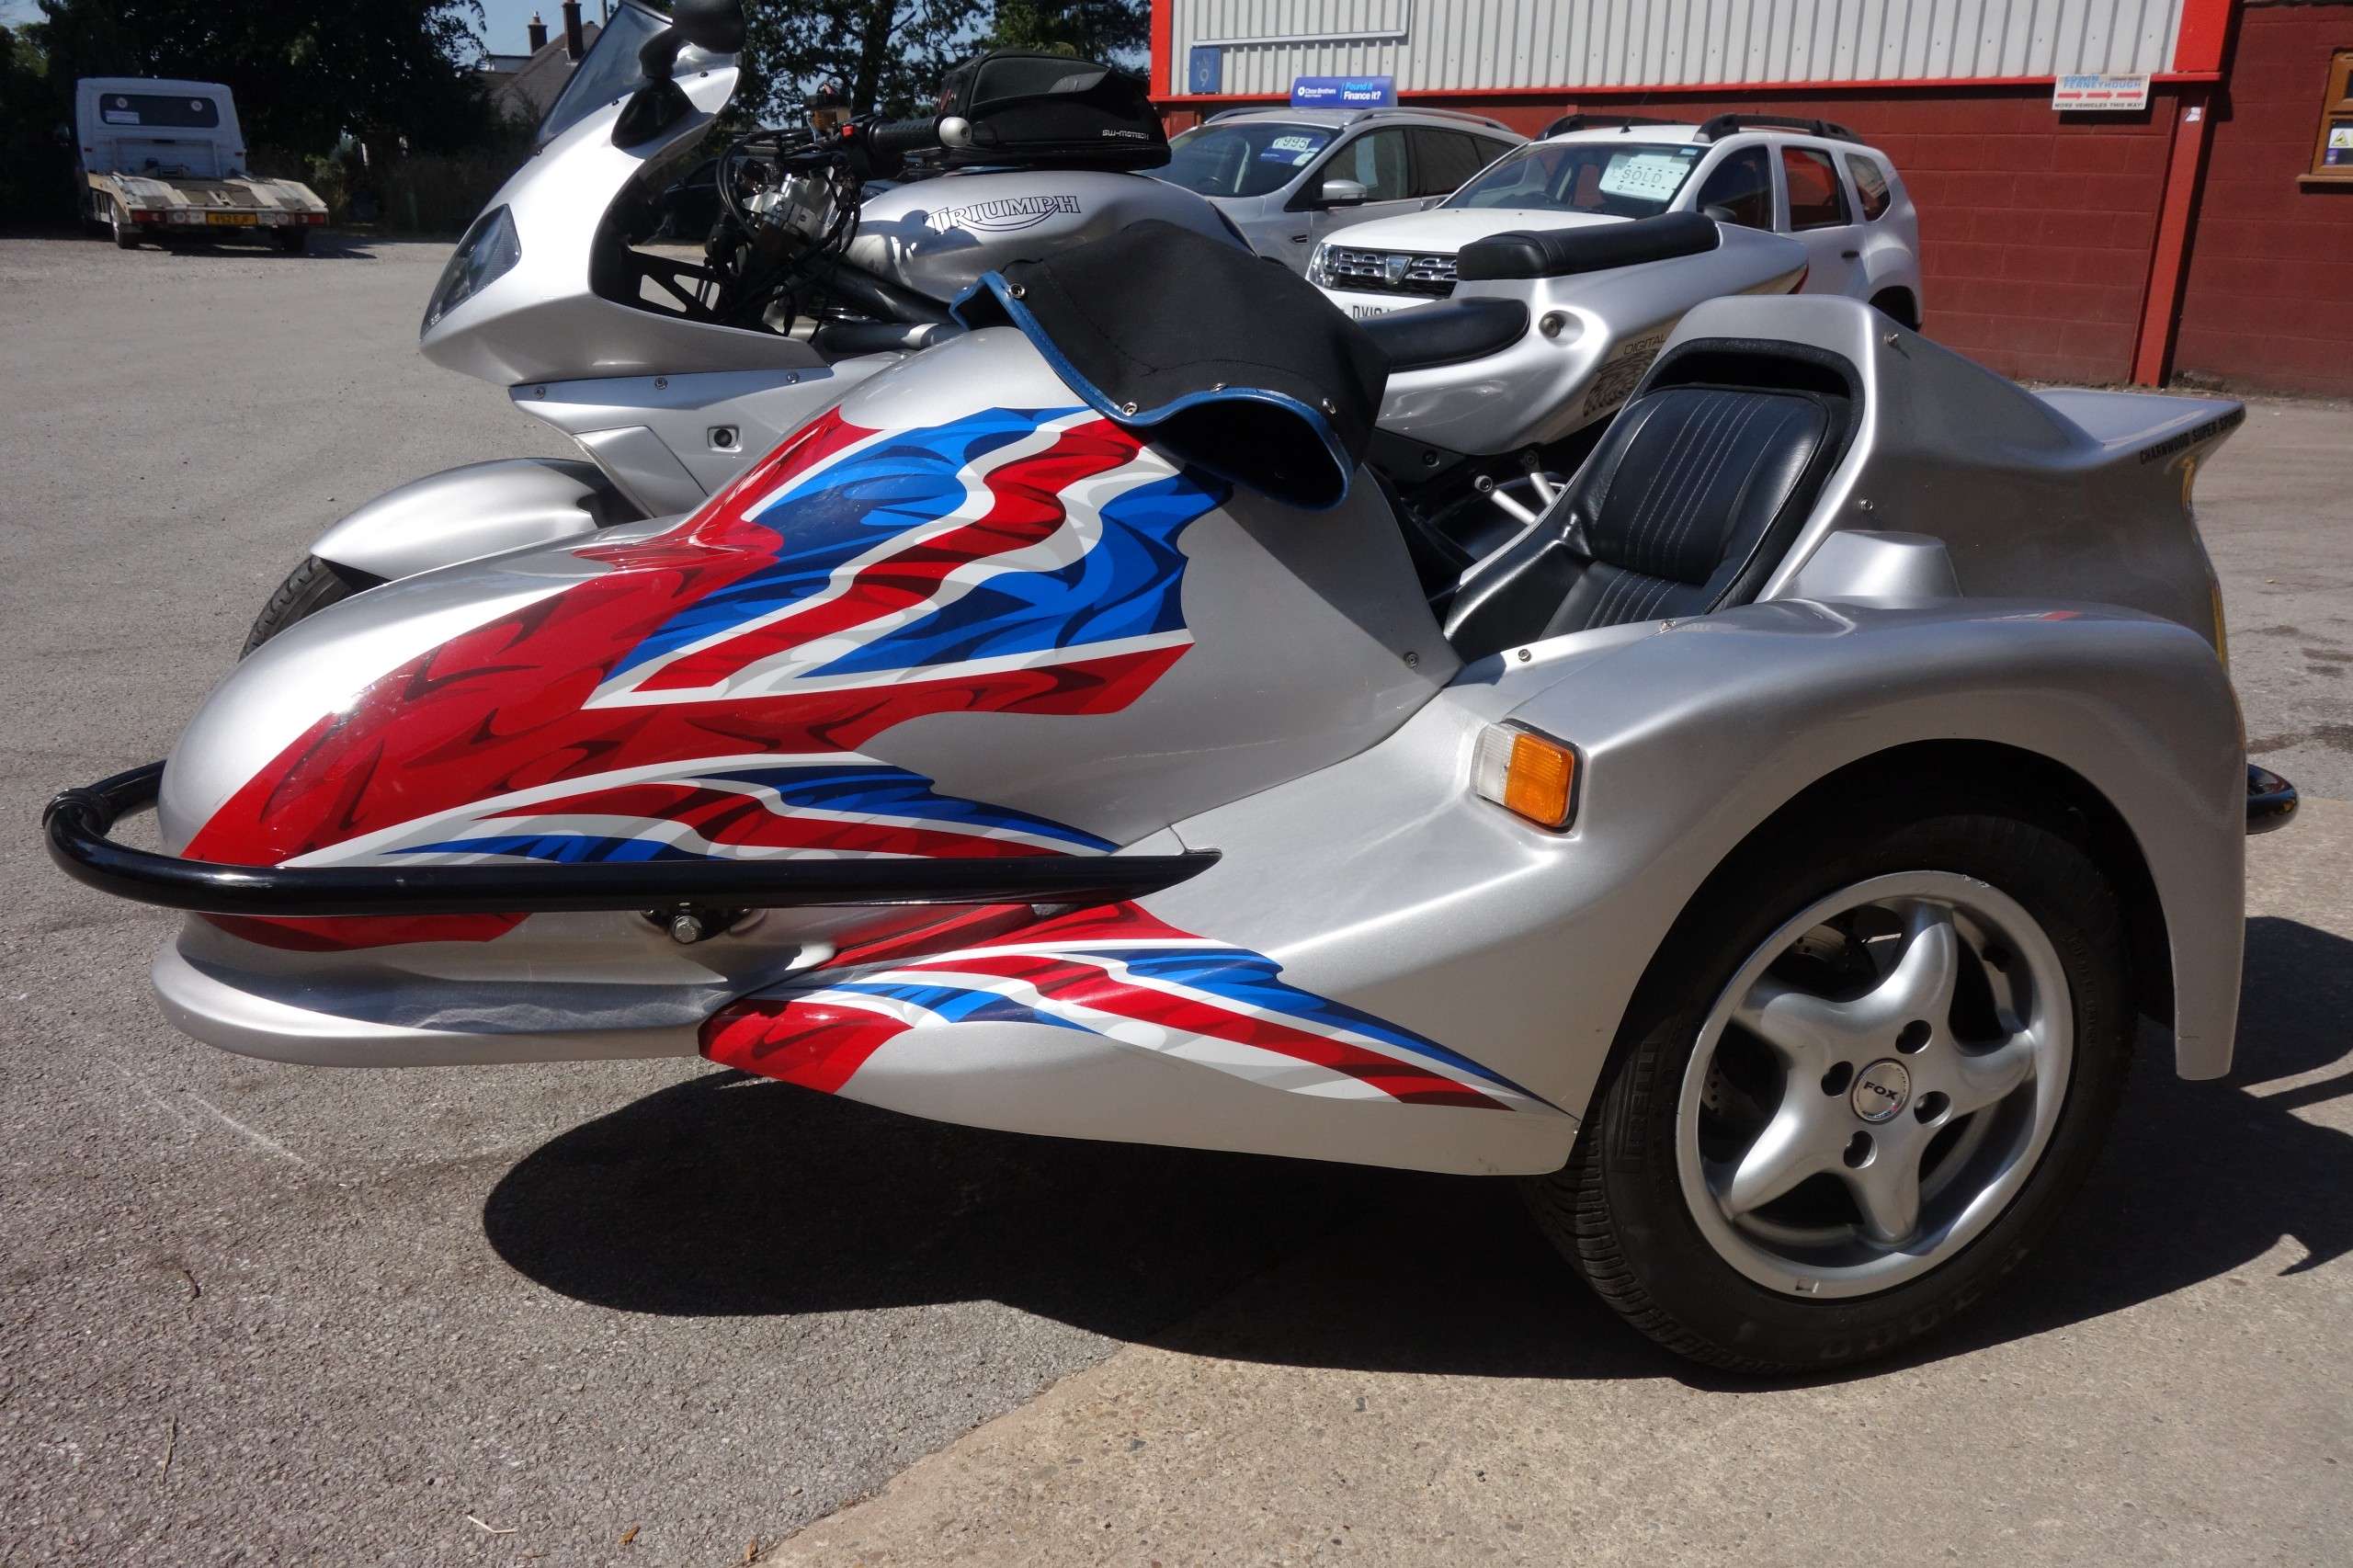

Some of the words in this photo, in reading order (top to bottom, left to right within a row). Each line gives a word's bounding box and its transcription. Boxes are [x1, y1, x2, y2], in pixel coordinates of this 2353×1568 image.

[1344, 91, 1370, 100] Finance
[1370, 90, 1381, 100] it?
[1345, 82, 1367, 90] Found
[1621, 168, 1663, 184] SOLD
[924, 195, 1081, 235] TRIUMPH
[1623, 333, 1666, 355] DIGITAL
[1863, 1080, 1899, 1101] FOX
